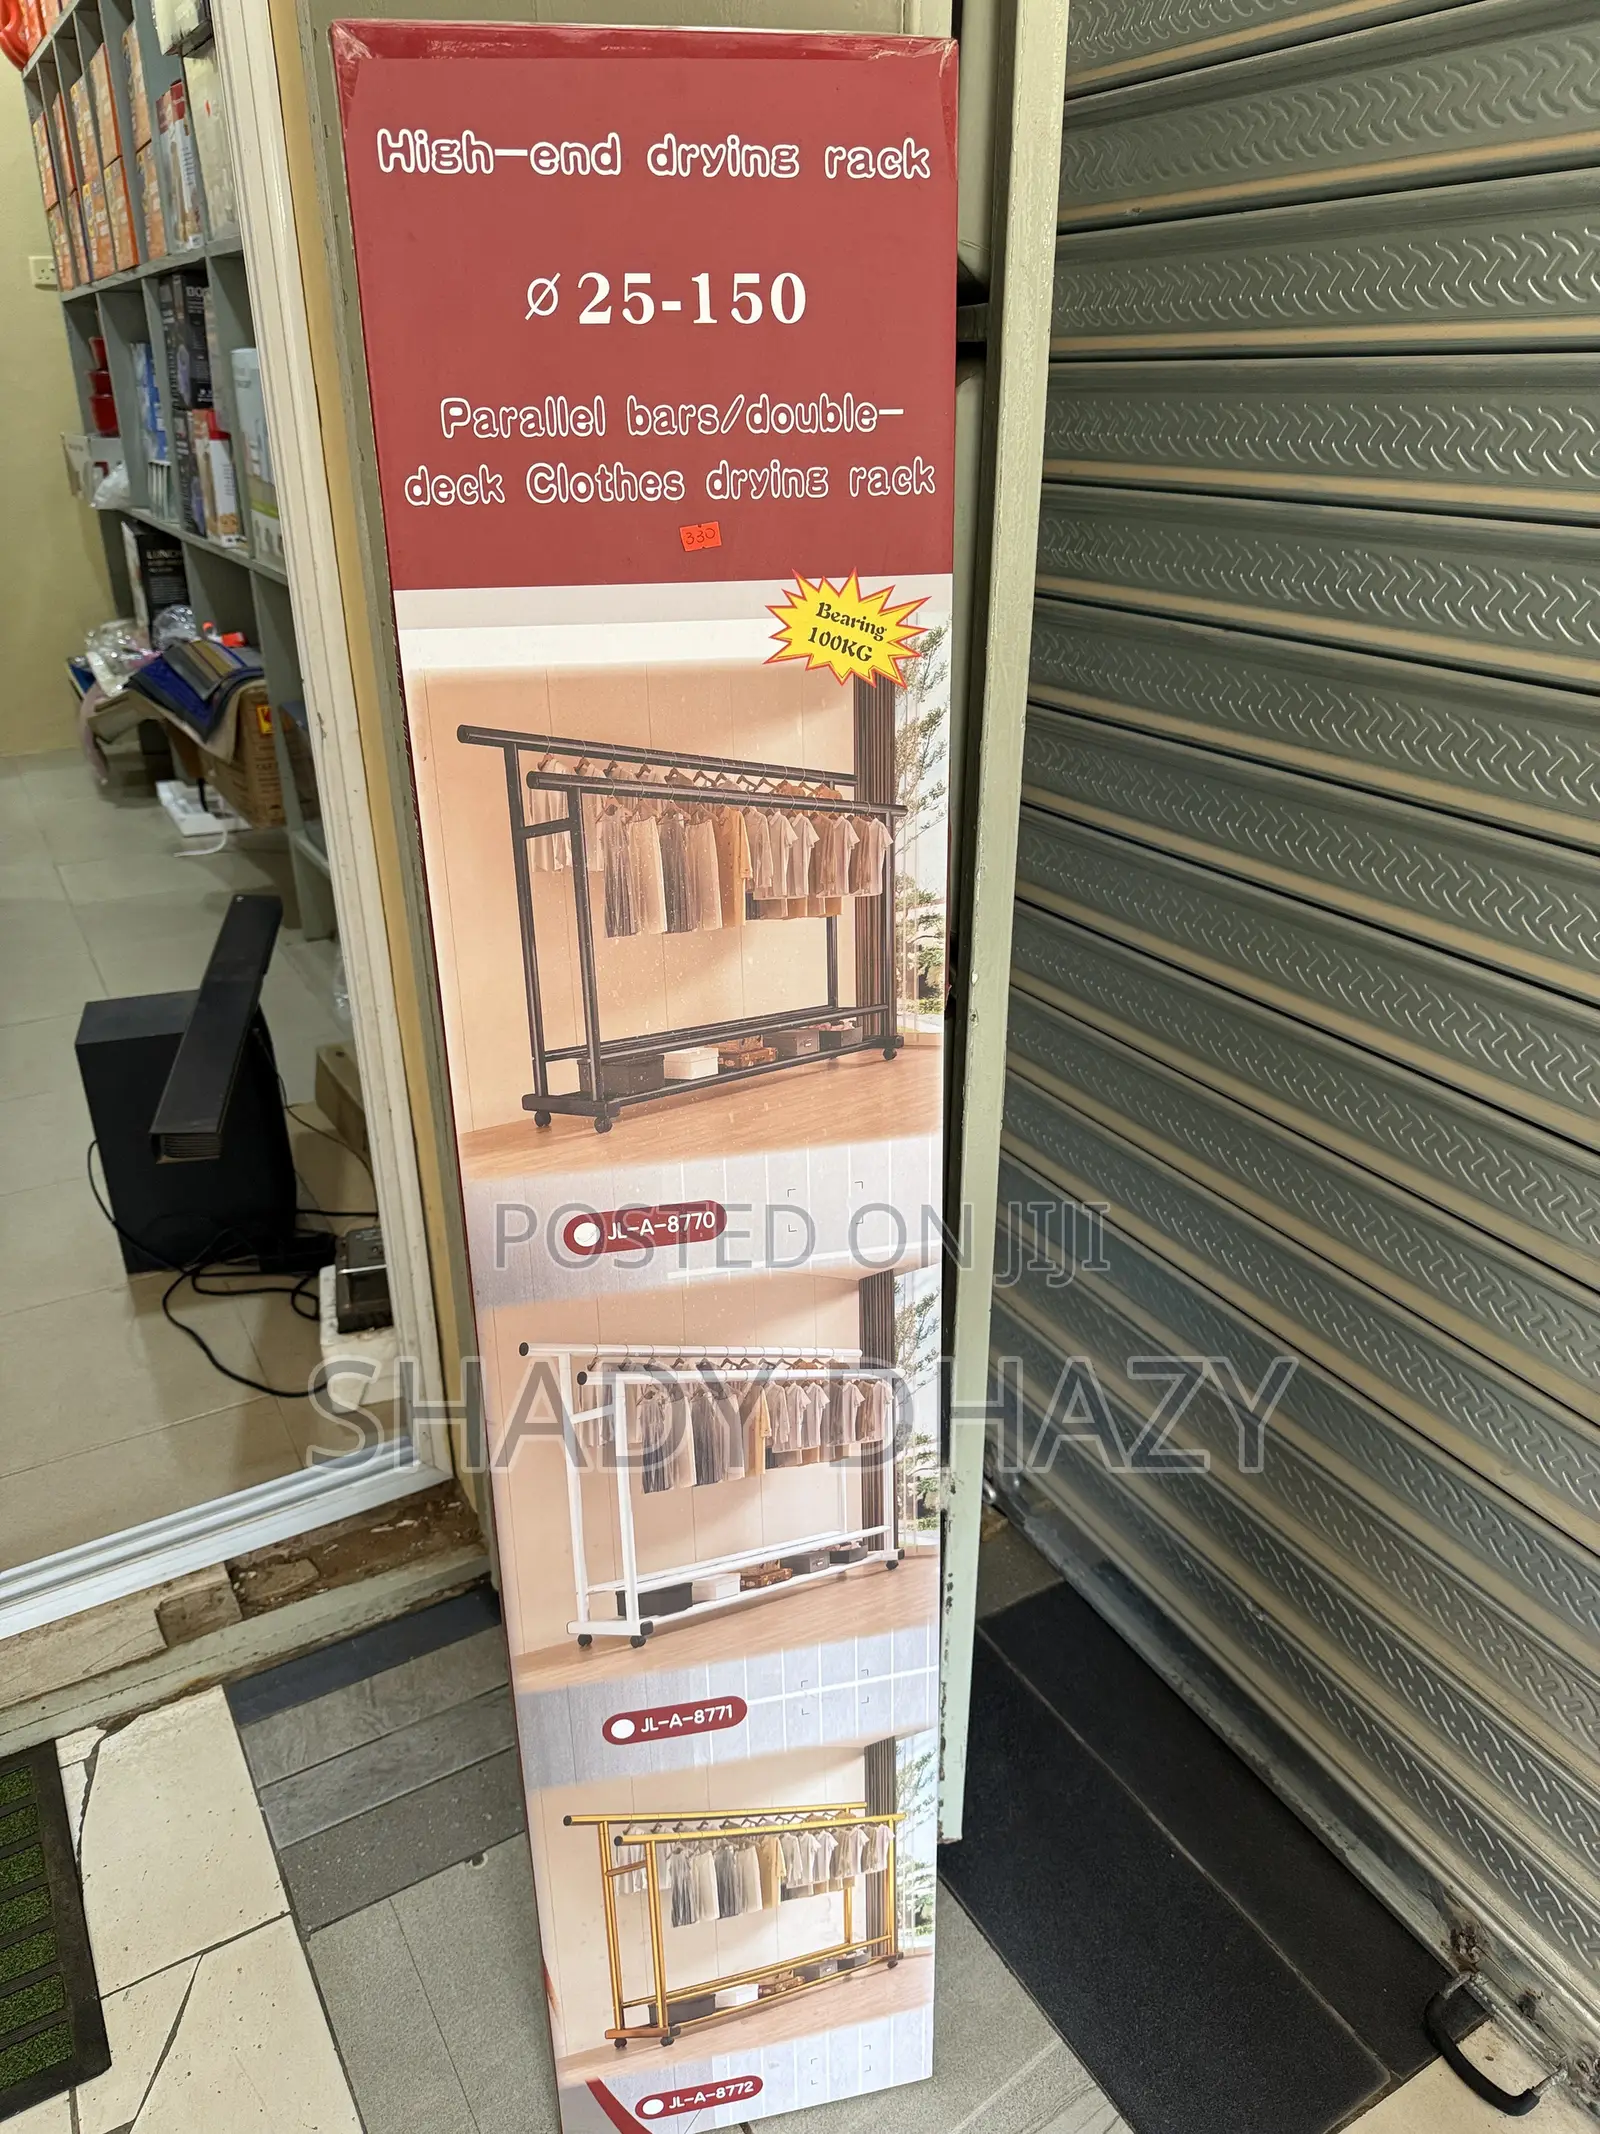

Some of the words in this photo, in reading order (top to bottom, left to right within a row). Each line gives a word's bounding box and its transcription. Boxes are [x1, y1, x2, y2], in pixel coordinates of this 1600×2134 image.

[377, 128, 621, 175] High-end
[647, 133, 799, 178] drying
[825, 138, 930, 179] rack
[578, 272, 806, 324] 25-150
[441, 395, 605, 438] Parallel
[627, 392, 904, 436] bars/double-
[405, 464, 505, 506] deck
[526, 462, 685, 503] Clothes
[706, 459, 828, 500] drying
[850, 456, 935, 497] rack
[685, 528, 716, 545] 330
[815, 602, 887, 642] Bearing
[808, 627, 873, 662] 100KG
[608, 1211, 716, 1241] JL-A-8770
[640, 1704, 733, 1734] JL-A-8771
[668, 2080, 754, 2109] JL-A-8772
